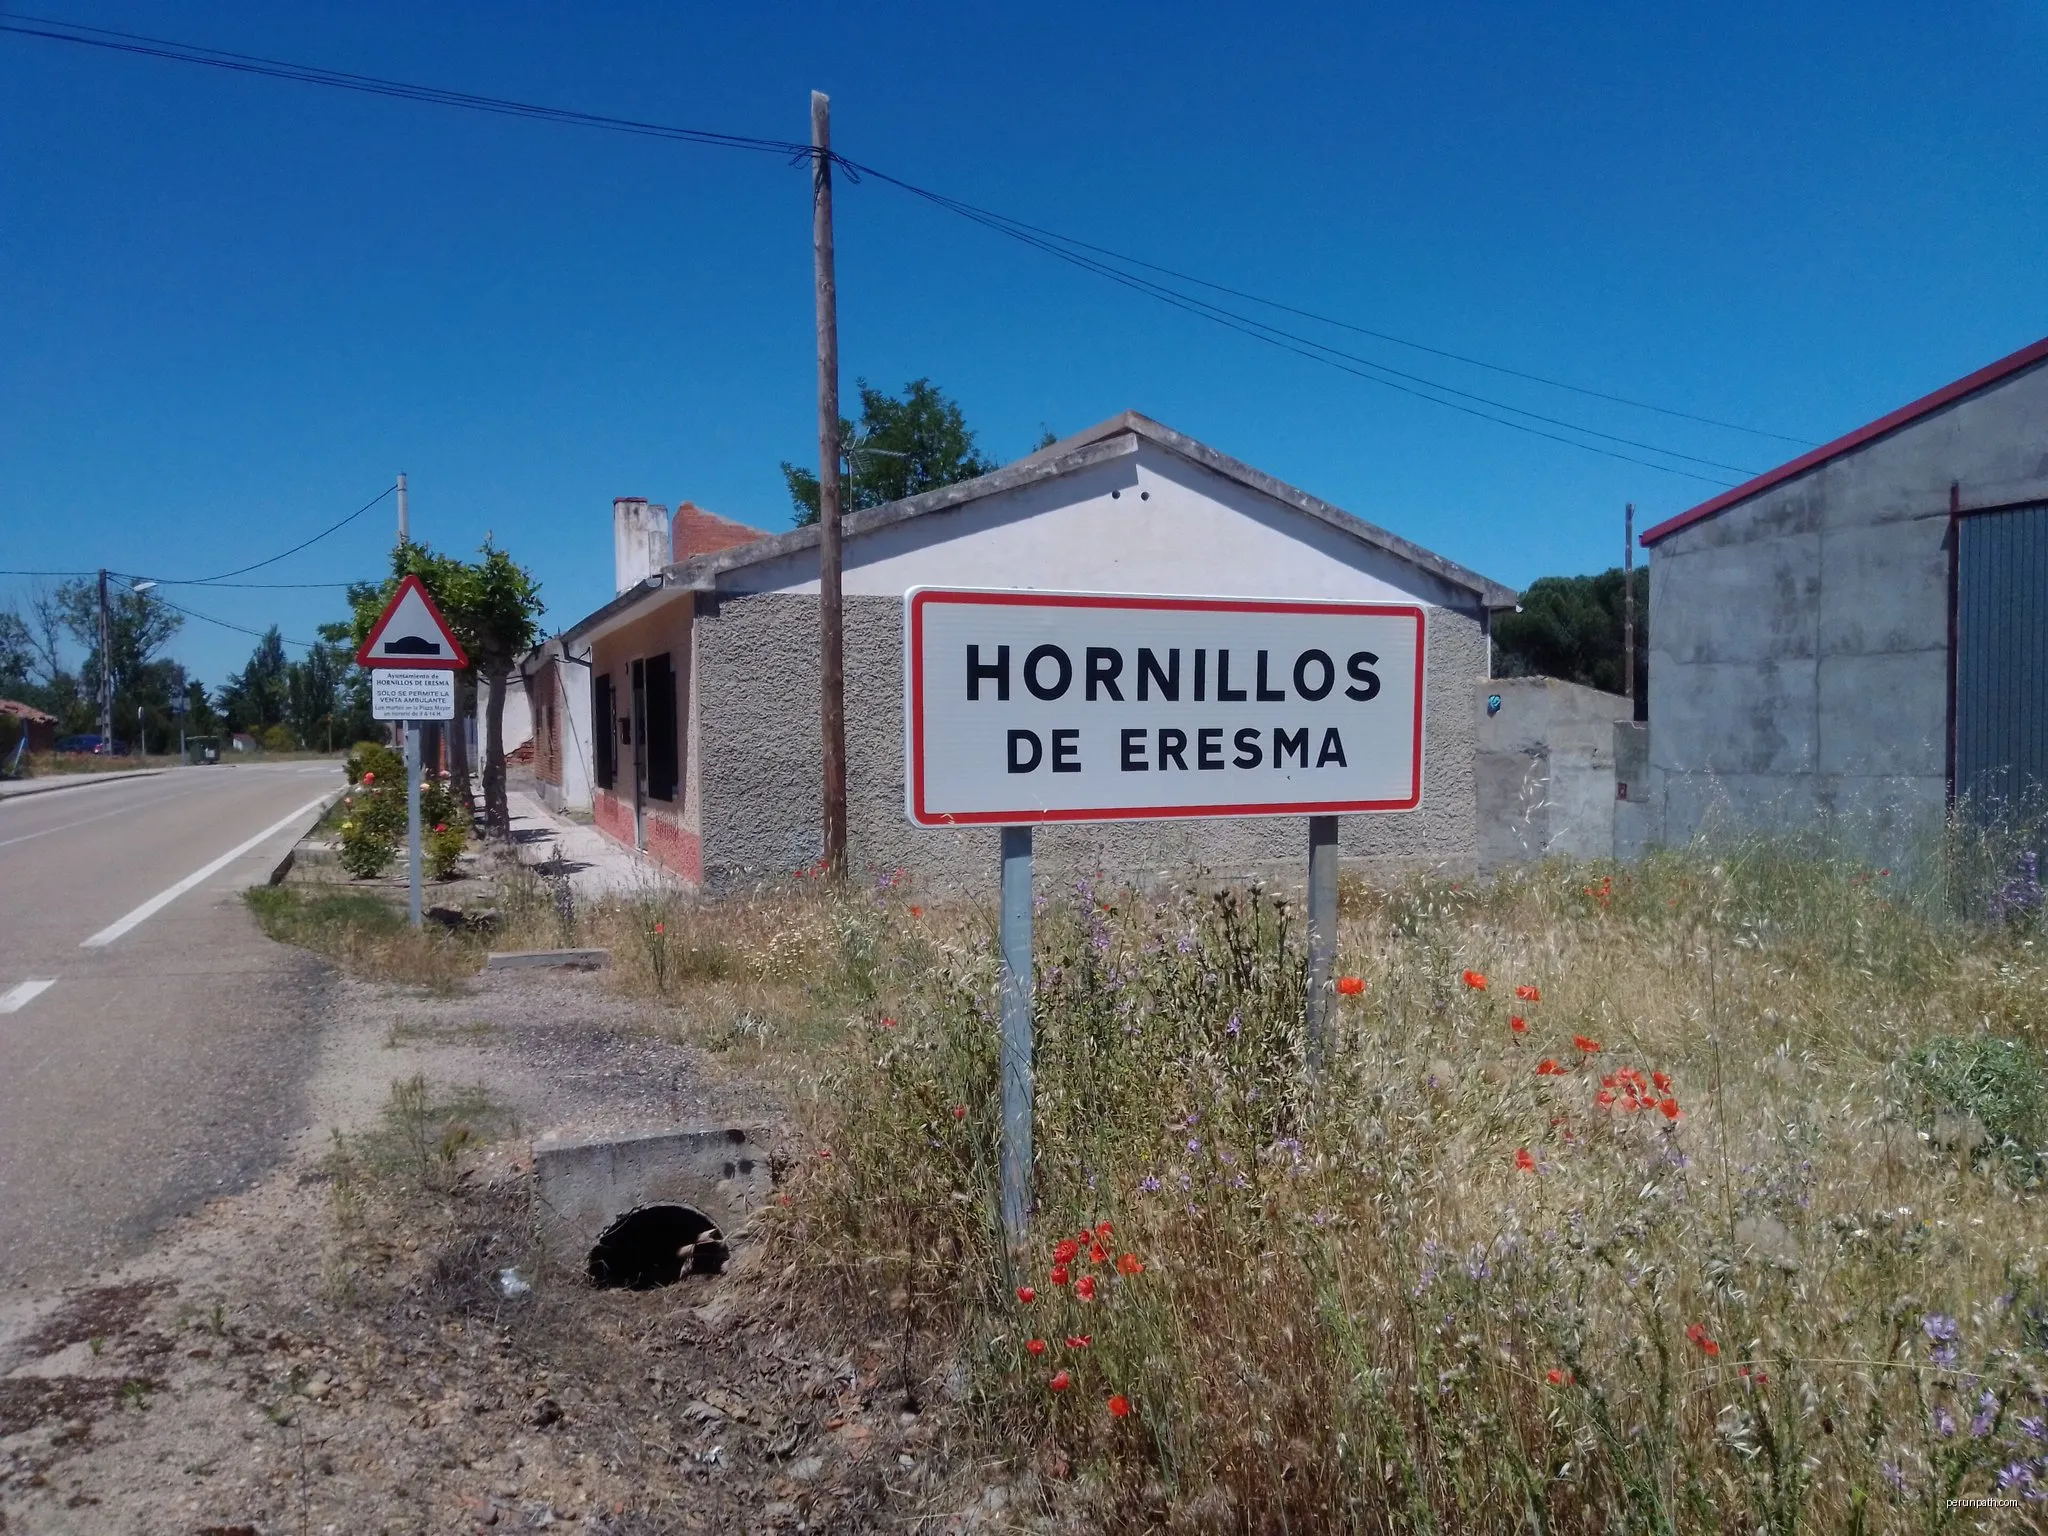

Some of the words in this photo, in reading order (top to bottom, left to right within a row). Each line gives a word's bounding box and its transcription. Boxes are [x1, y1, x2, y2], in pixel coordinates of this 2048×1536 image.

[966, 643, 1382, 702] HORNILLOS
[1007, 728, 1082, 774] DE
[1120, 727, 1348, 772] ERESMA
